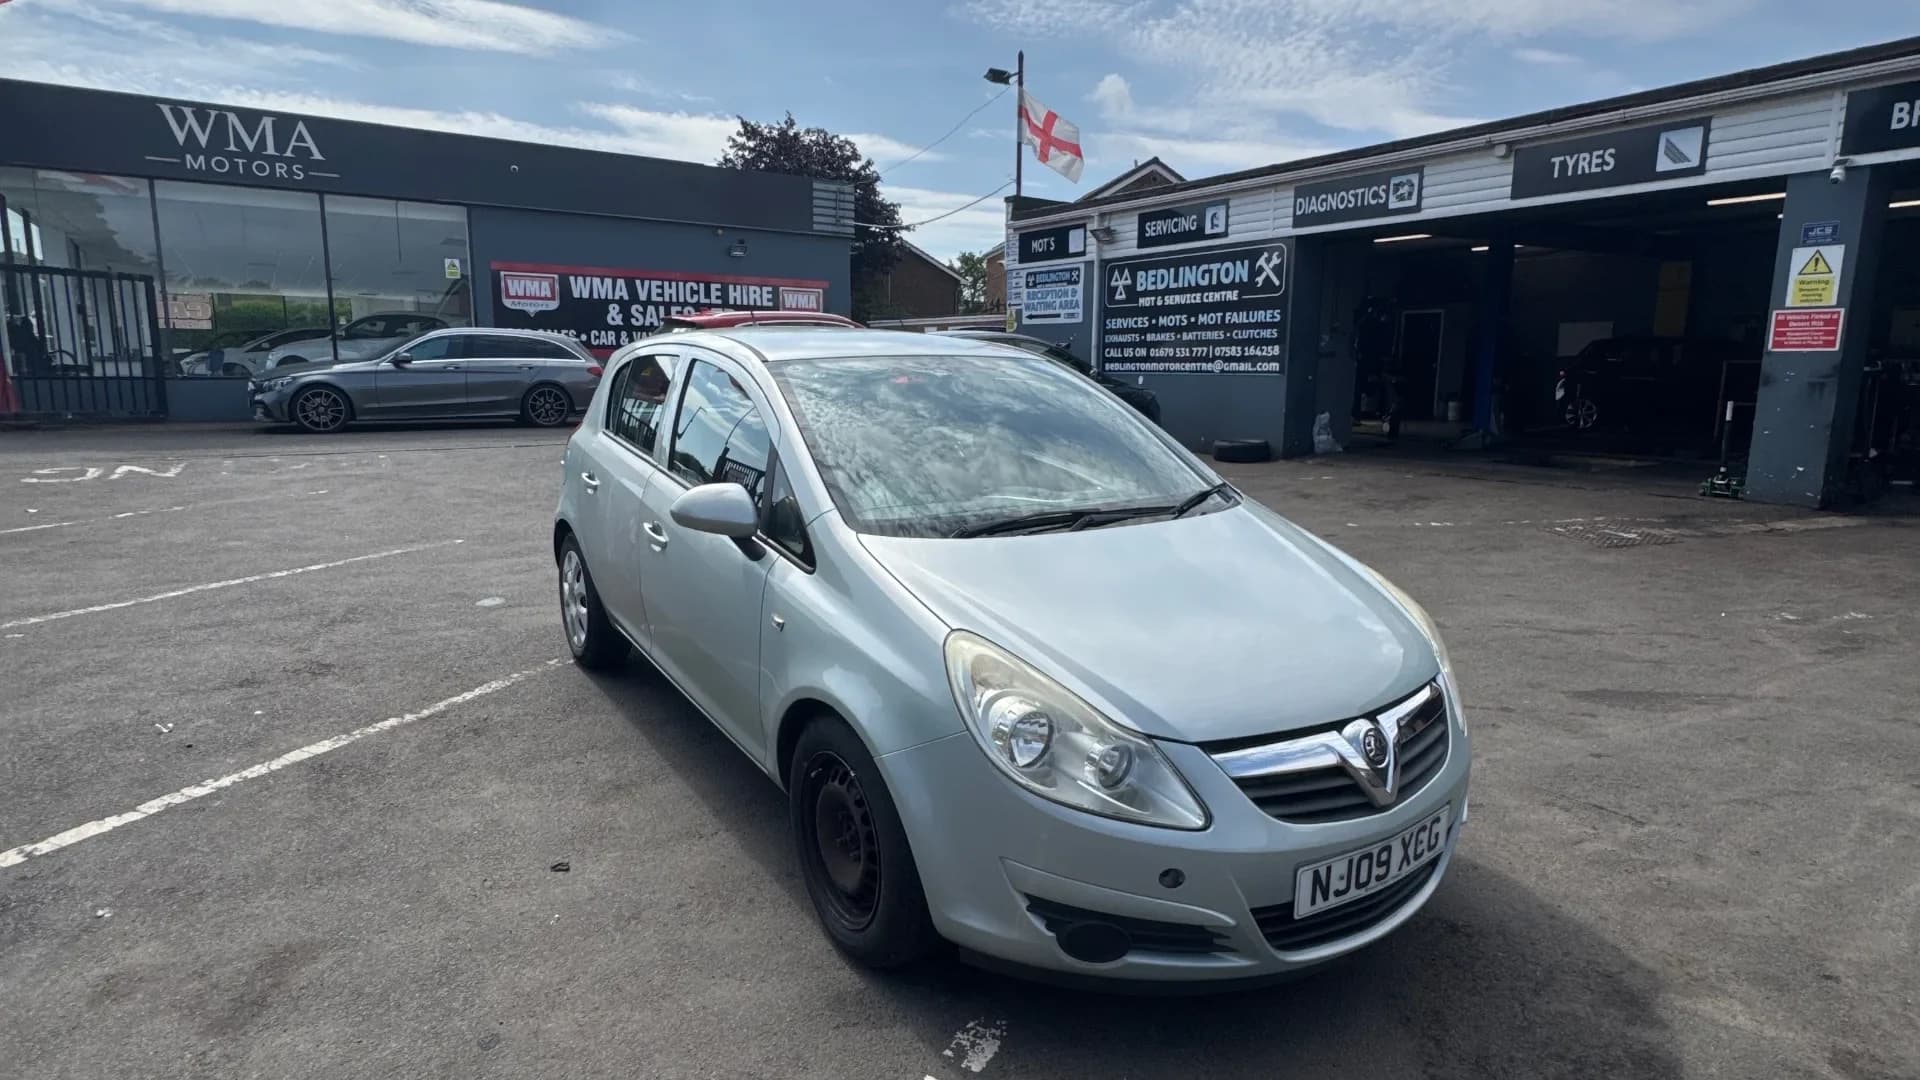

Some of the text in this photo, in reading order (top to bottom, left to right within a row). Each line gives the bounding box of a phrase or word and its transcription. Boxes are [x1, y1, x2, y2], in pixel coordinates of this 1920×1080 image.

[156, 103, 326, 160] WMA
[185, 153, 305, 180] MOTORS
[1551, 148, 1616, 179] TYRES
[1295, 184, 1387, 216] DIAGNOSTICS
[1144, 214, 1198, 238] SERVICING
[1136, 259, 1249, 292] BEDLINGTON
[507, 279, 552, 298] WMA
[569, 275, 773, 307] WMA VEHICLE HIRE
[1026, 288, 1069, 301] RECEPTION
[1138, 295, 1157, 308] MOT
[1164, 292, 1202, 306] SERVICE
[1203, 290, 1239, 304] CENTRE
[783, 292, 817, 310] WMA
[1024, 299, 1080, 312] WAITING AREA
[606, 303, 624, 326] &
[1105, 309, 1281, 330] SERVICES MOTS MOT FAILURES
[590, 330, 617, 346] CAR
[1105, 328, 1278, 343] EXHAUSTS BRAKES BATTERIES CLUTCHES
[1105, 348, 1123, 358] CALL
[1124, 348, 1134, 357] US
[1135, 348, 1147, 357] ON
[1149, 347, 1174, 358] 01670
[1175, 347, 1190, 357] 531
[1192, 347, 1208, 357] 777
[1310, 816, 1442, 907] NJ09 XEG
